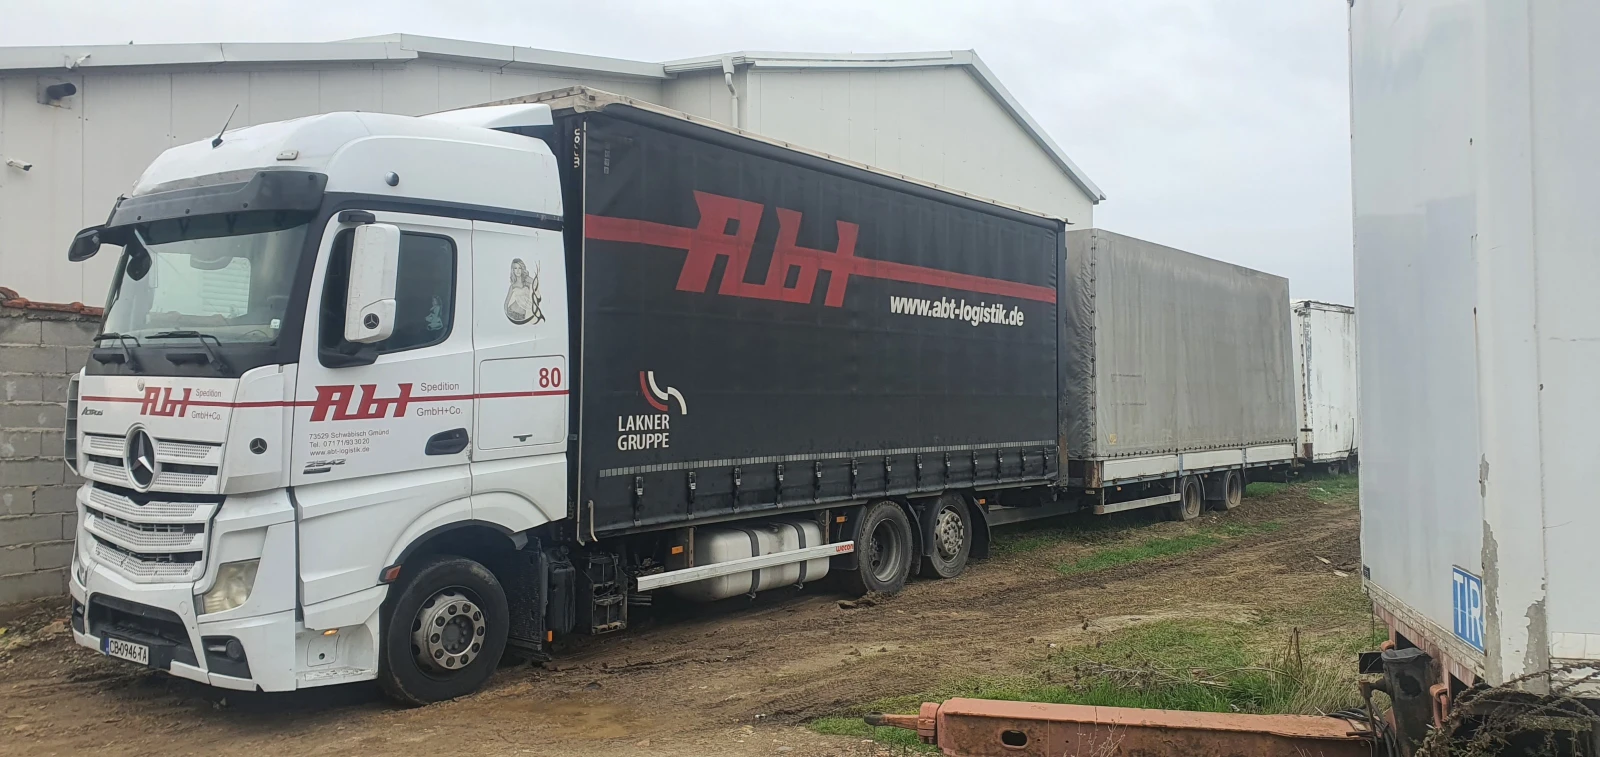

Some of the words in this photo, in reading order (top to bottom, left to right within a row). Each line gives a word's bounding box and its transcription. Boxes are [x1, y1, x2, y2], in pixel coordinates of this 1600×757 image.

[676, 189, 860, 308] Abt
[890, 295, 1025, 327] www.abt-logistik.de
[539, 367, 562, 388] 80
[195, 388, 222, 398] Spedition
[420, 382, 460, 393] Spedition
[140, 386, 192, 418] Abt
[309, 383, 413, 422] Abt
[416, 405, 463, 417] GmbH+Co.
[191, 410, 222, 421] GmbH+Co.
[618, 414, 670, 432] LAKNER
[309, 432, 329, 440] 73529
[331, 430, 367, 439] Schwäbisch
[368, 428, 390, 437] Gmünd
[617, 432, 670, 451] GRUPPE
[309, 446, 370, 456] www.abt-logistik.de
[304, 458, 347, 468] 2542
[1453, 571, 1484, 648] TIR
